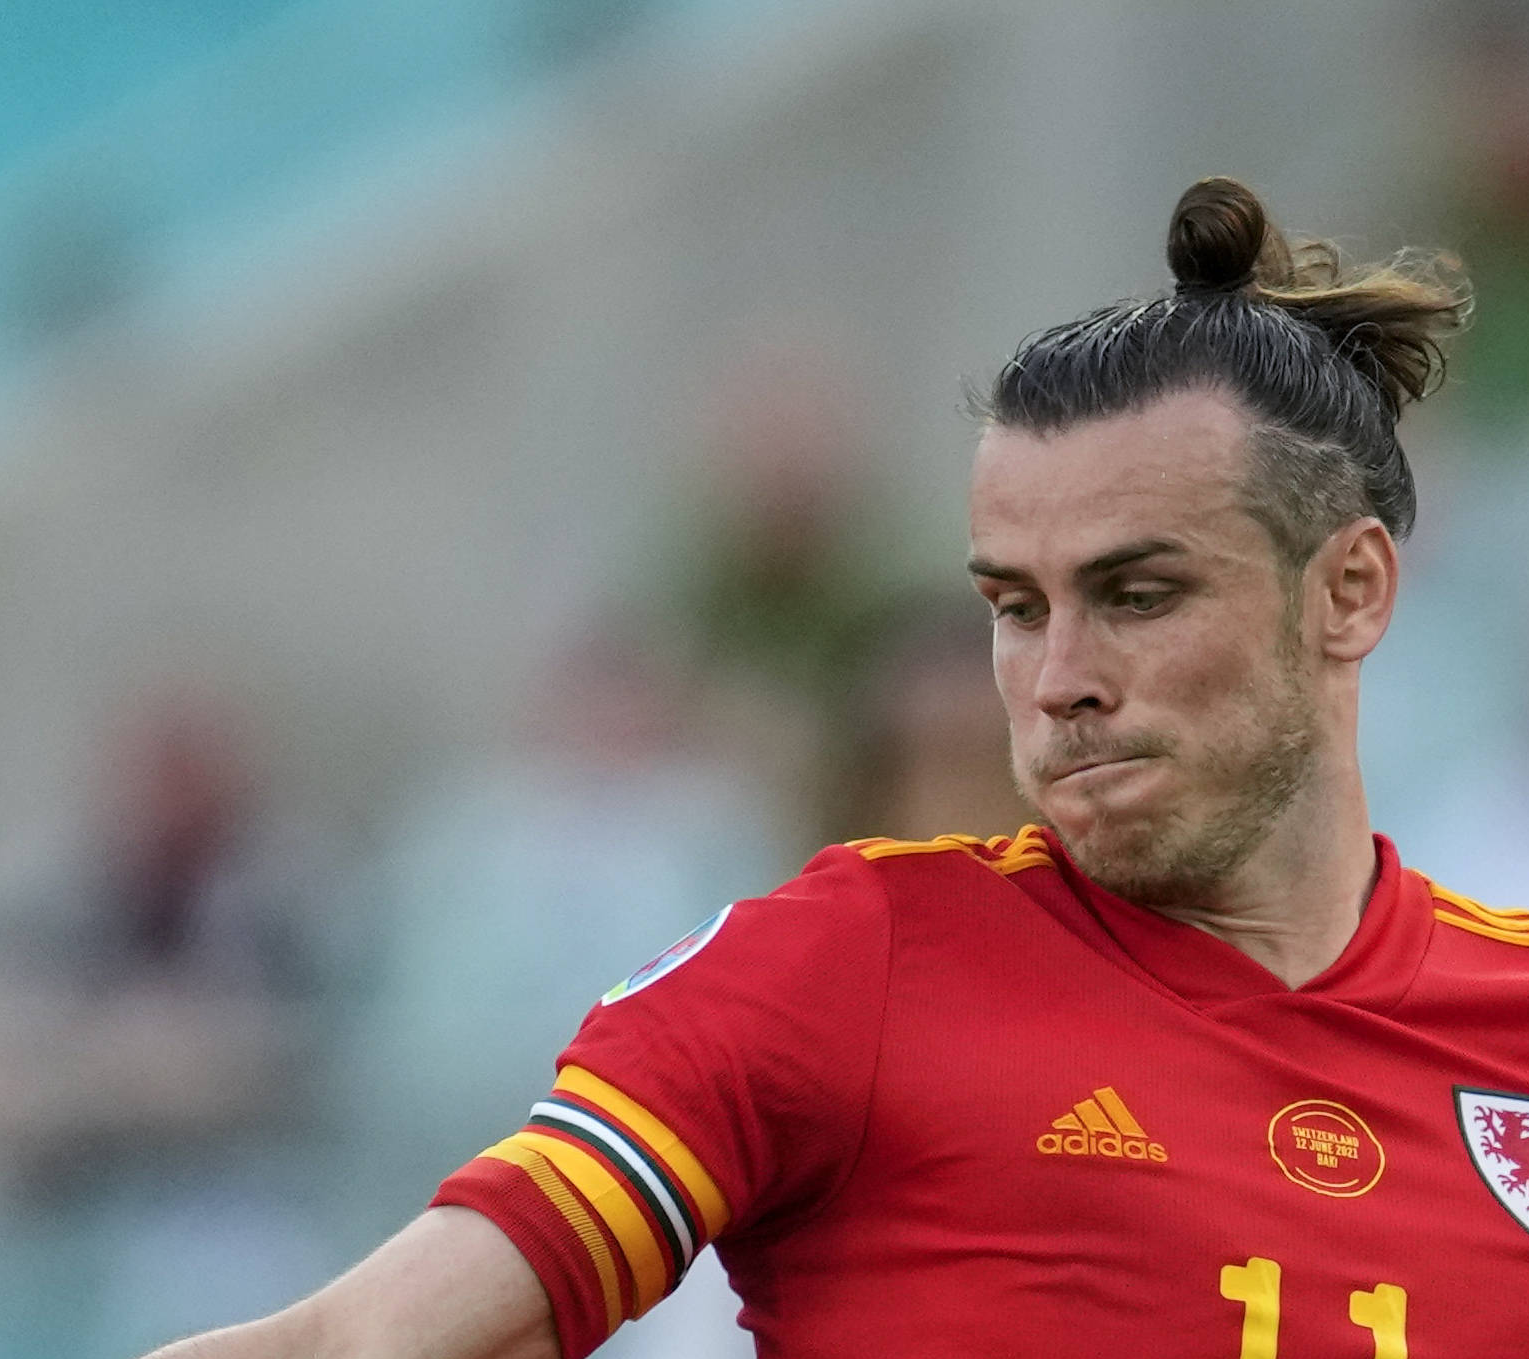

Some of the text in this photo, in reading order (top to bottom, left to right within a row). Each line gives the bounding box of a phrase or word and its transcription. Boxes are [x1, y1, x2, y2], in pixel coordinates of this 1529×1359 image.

[1036, 1127, 1169, 1163] adidas
[1291, 1126, 1360, 1148] SWITZERLAND
[1295, 1137, 1359, 1160] 12 JUNE 2021
